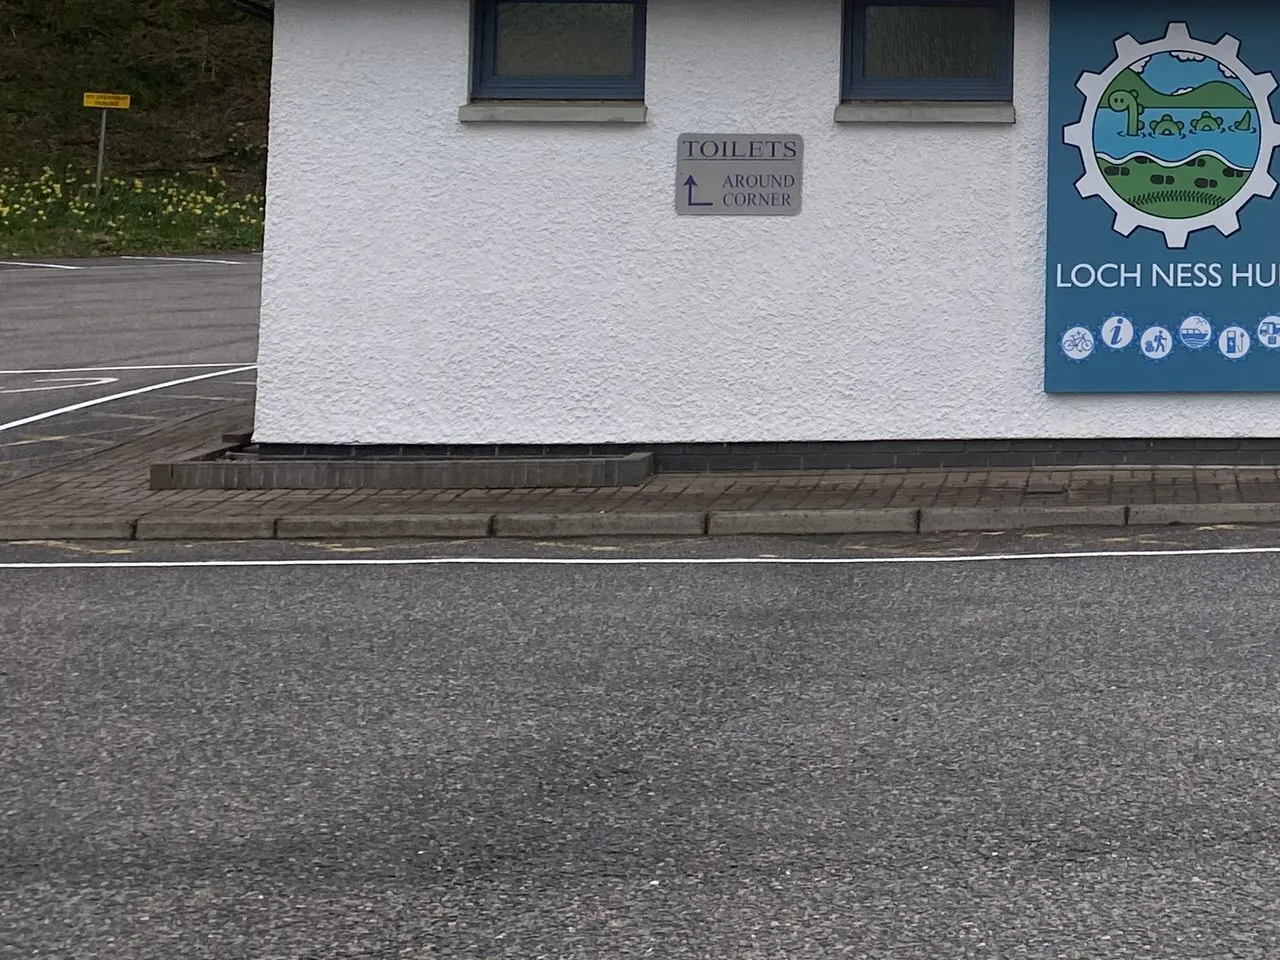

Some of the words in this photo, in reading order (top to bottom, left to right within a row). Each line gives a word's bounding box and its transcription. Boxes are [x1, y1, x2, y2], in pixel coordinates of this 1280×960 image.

[683, 140, 797, 158] TOILETS
[722, 174, 795, 188] AROUND
[722, 192, 791, 207] CORNER
[1056, 263, 1141, 288] LOCH
[1151, 263, 1222, 288] NESS
